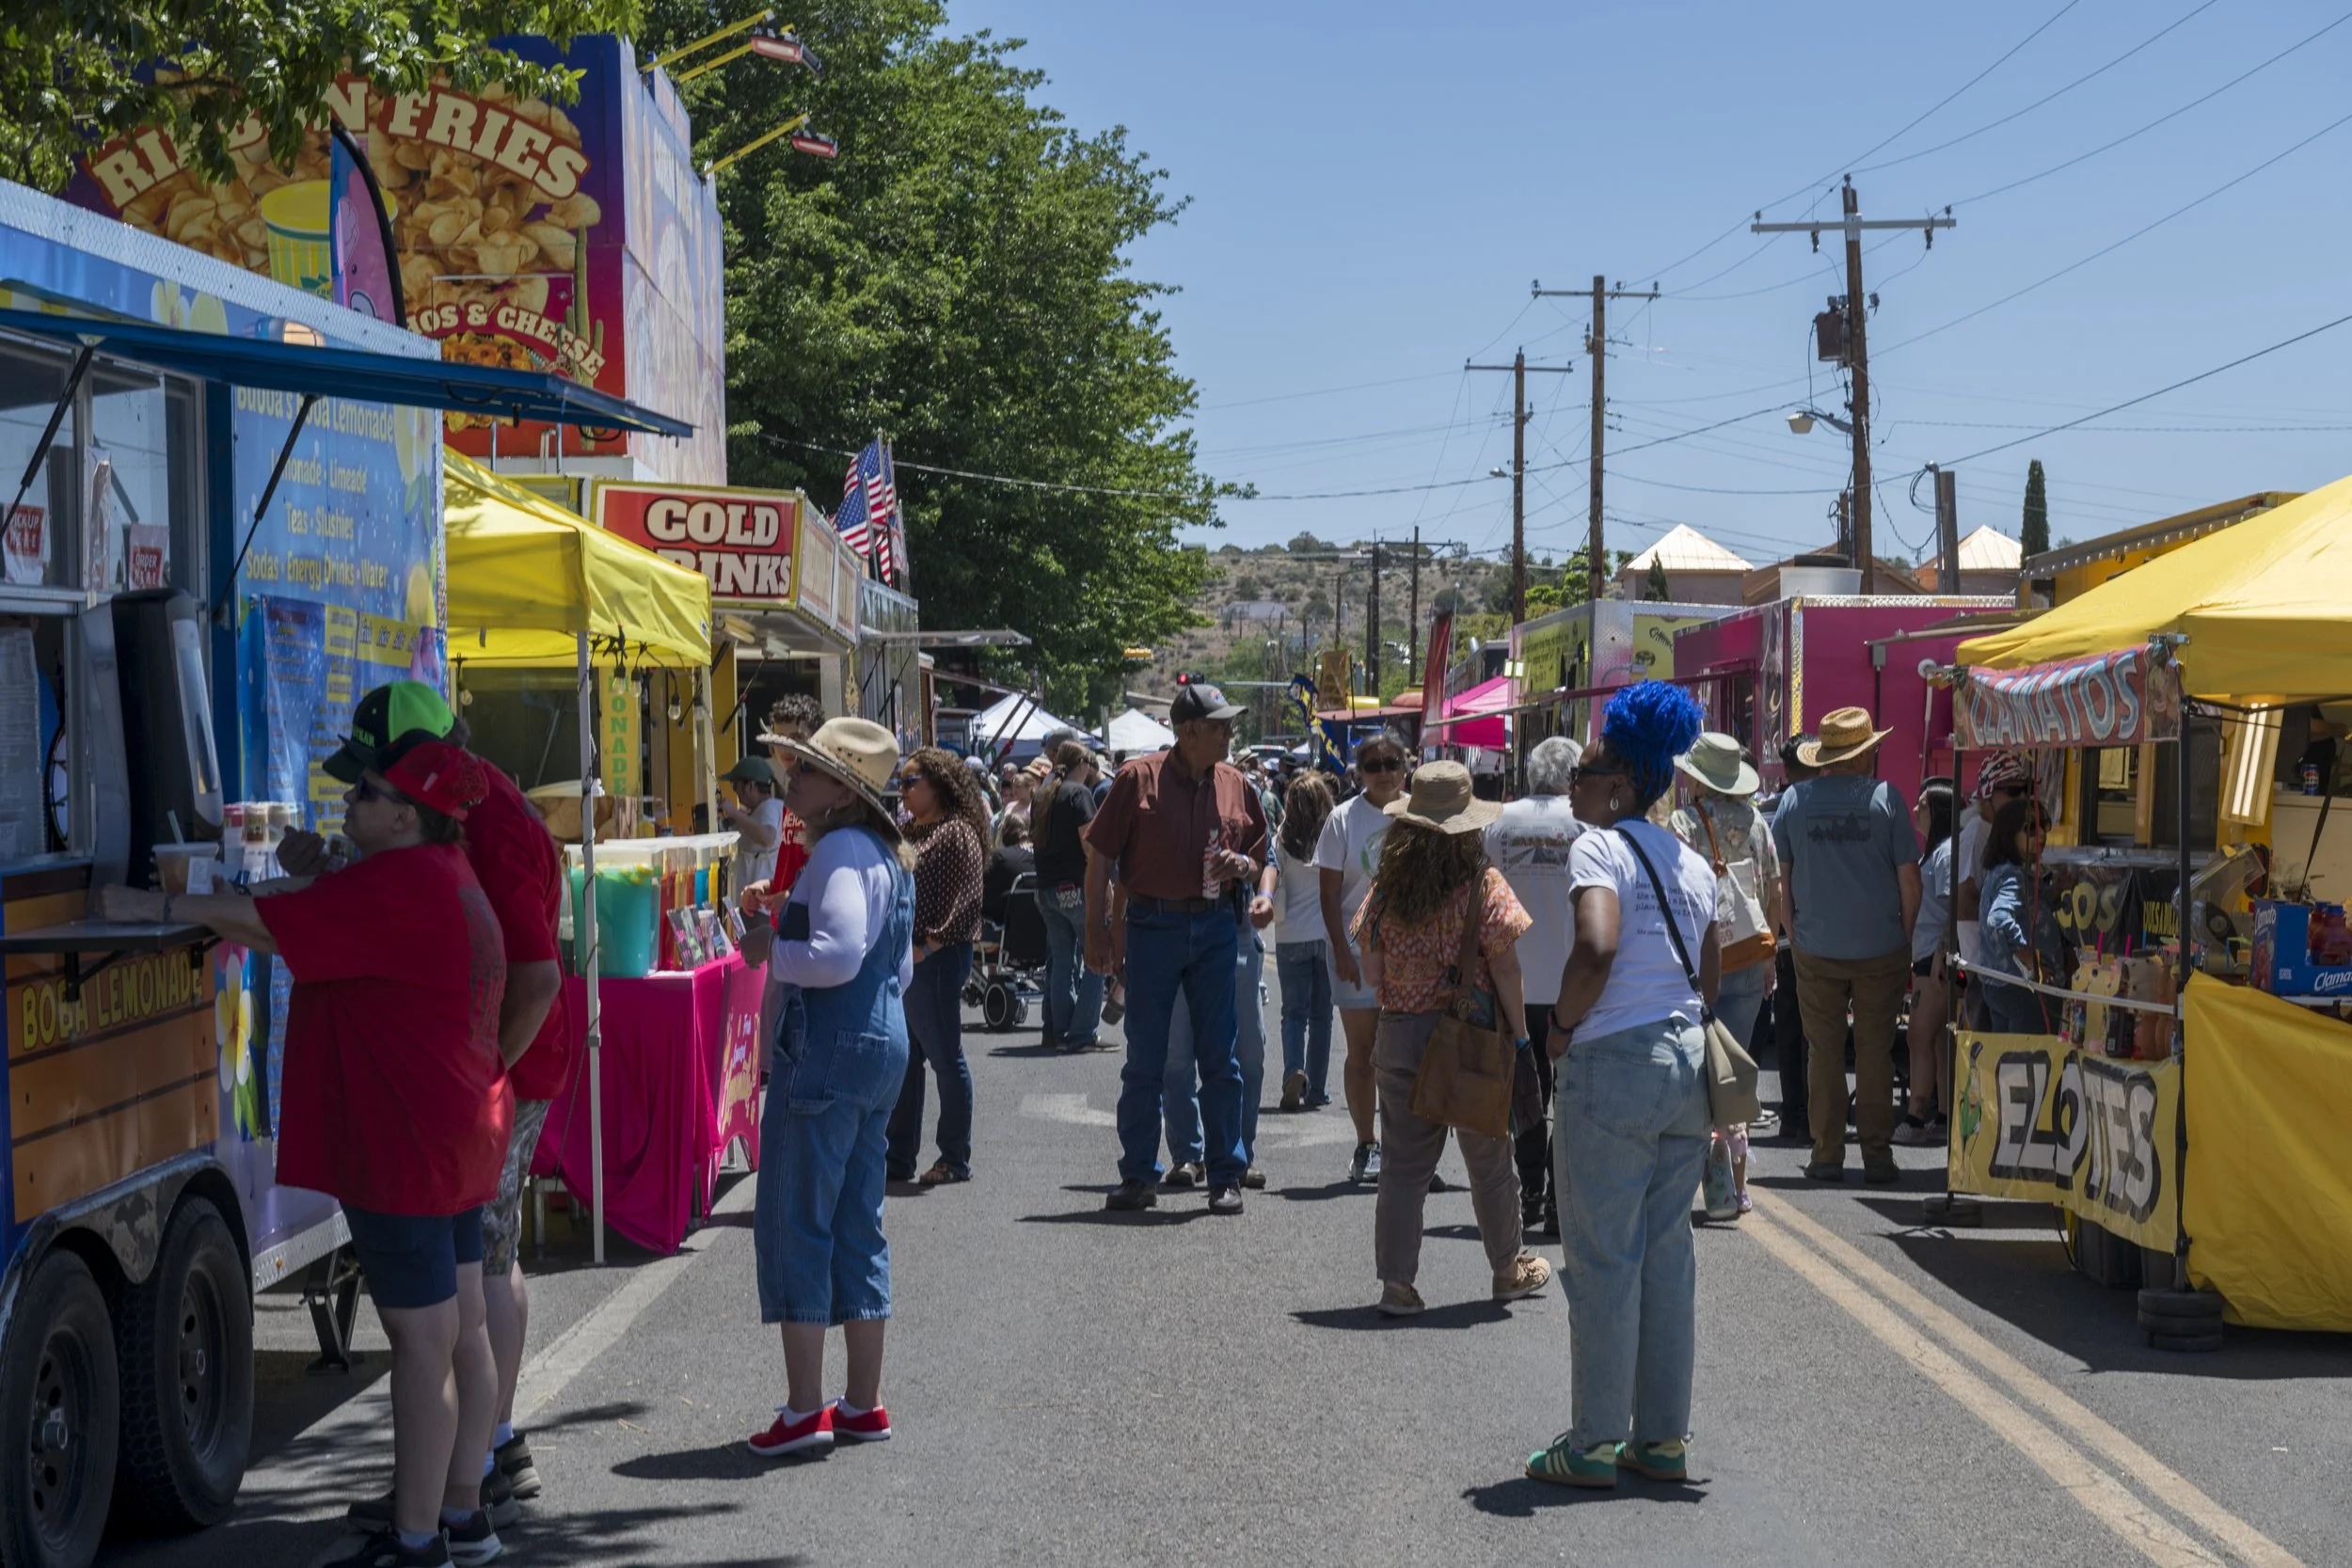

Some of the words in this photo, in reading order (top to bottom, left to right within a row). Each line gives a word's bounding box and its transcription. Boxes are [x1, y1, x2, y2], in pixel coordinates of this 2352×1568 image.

[388, 88, 588, 199] FRIES
[467, 303, 488, 326] &
[497, 305, 606, 376] CHEESE
[332, 395, 394, 444] Lemonade
[330, 459, 368, 495] Limeade
[285, 501, 309, 534] Teas
[316, 505, 355, 541] Slushies
[644, 498, 780, 547] COLD
[246, 548, 279, 579] Sodas
[286, 550, 322, 592] Energy
[324, 553, 355, 588] Drinks
[360, 557, 389, 590] Water
[1970, 649, 2140, 748] CLAMATOS
[22, 977, 90, 1051] BOBA
[95, 948, 203, 1029] LEMONADE
[2313, 971, 2352, 991] Clama
[1989, 1049, 2161, 1224] ELOTES
